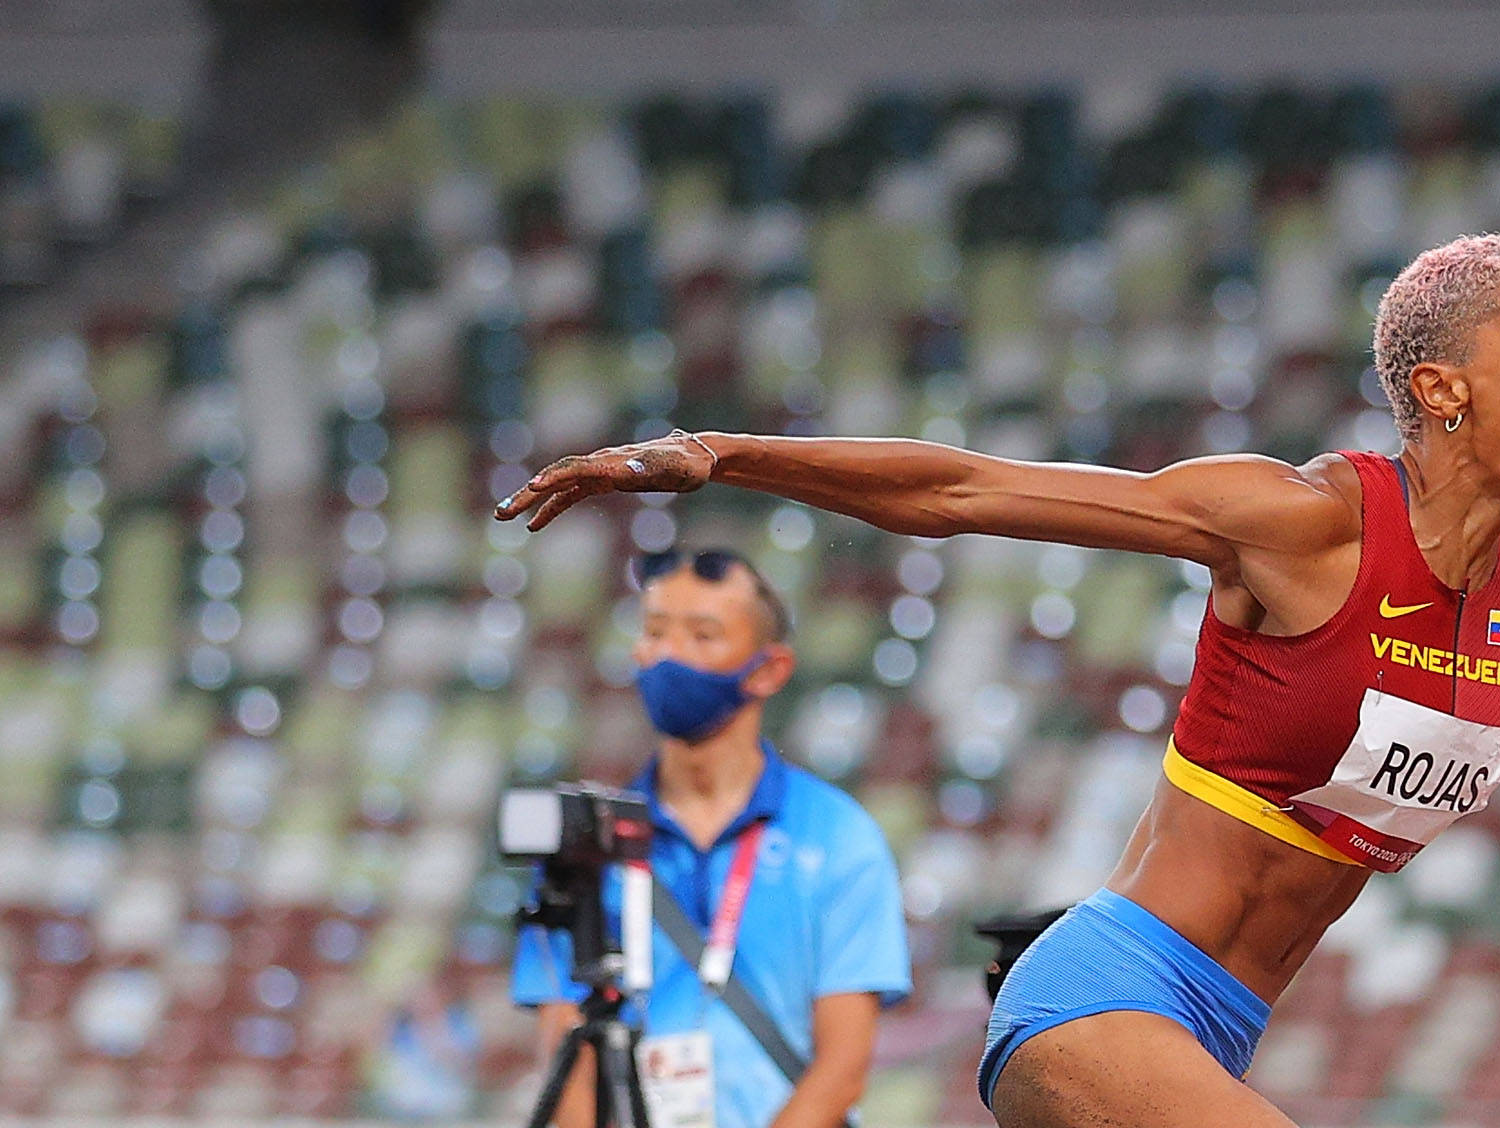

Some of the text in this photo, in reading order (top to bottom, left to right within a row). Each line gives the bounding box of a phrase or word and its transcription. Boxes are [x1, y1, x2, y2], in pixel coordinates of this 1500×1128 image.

[1369, 742, 1489, 813] ROJAS
[1348, 833, 1398, 862] TOKYO 2020
